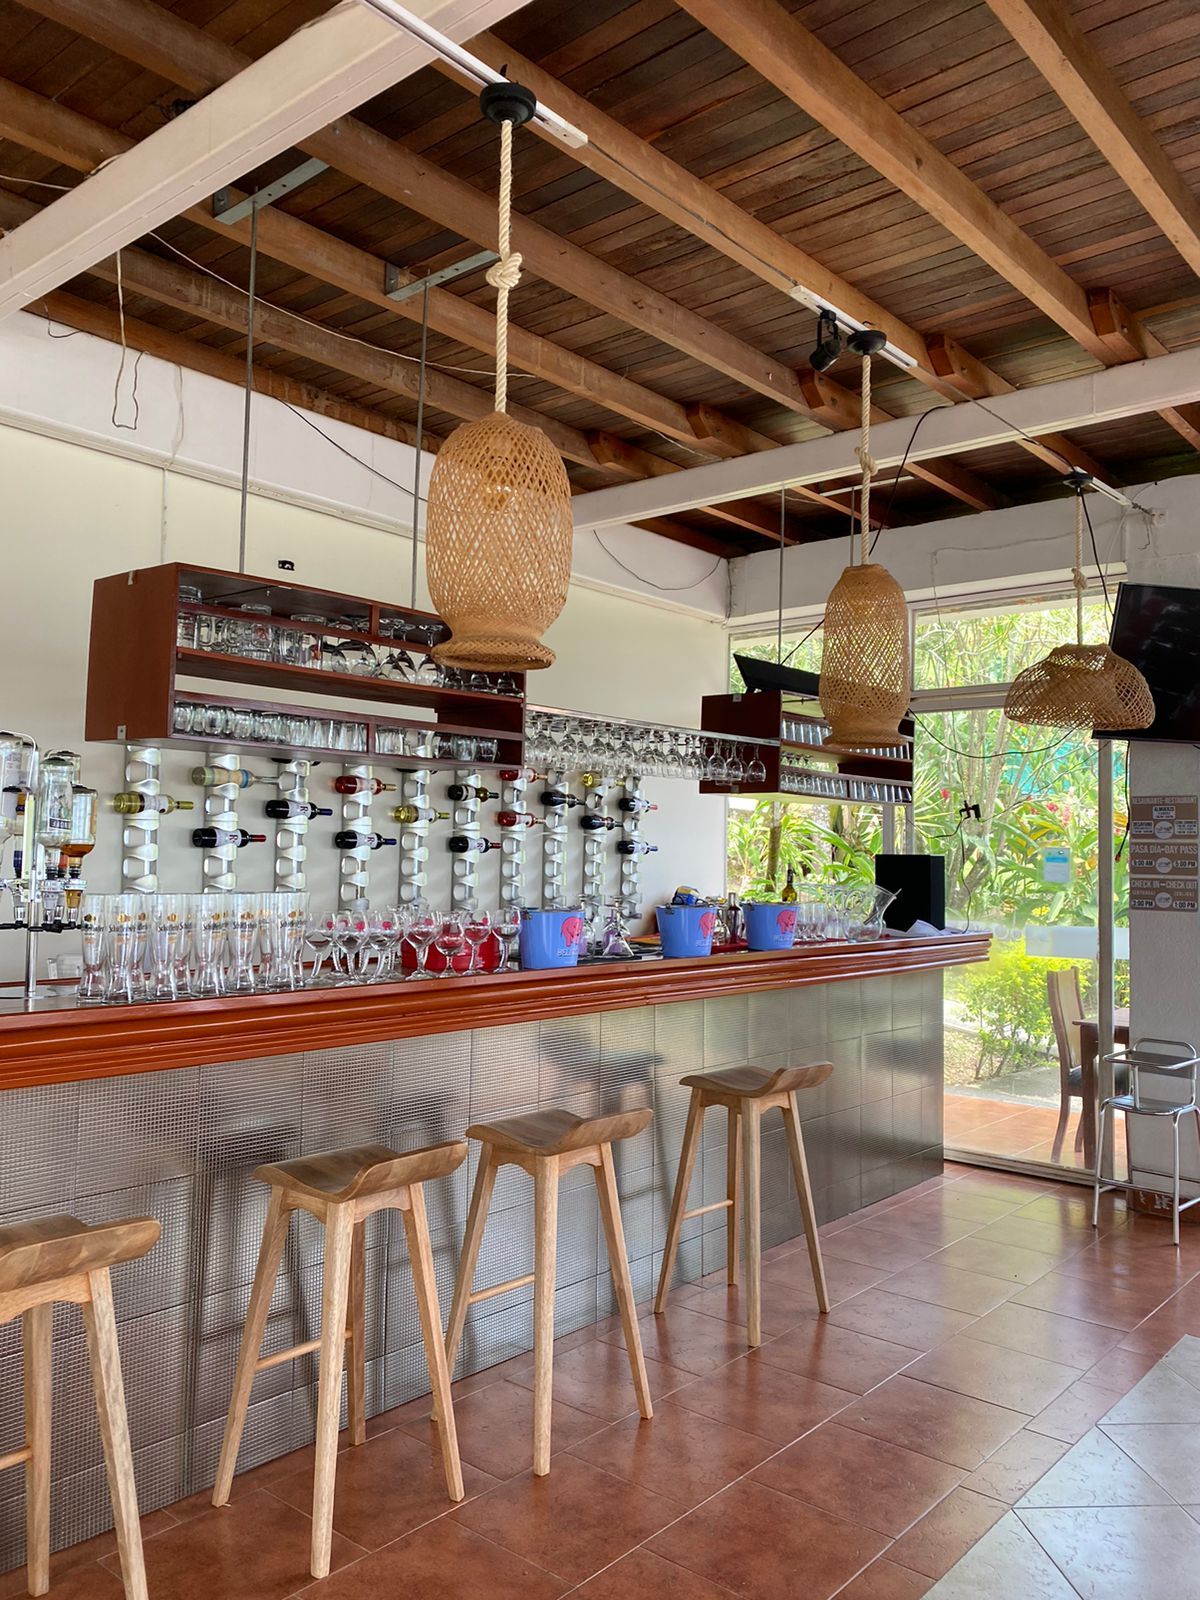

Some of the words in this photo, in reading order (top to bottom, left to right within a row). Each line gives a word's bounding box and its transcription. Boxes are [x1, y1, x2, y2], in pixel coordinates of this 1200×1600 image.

[1179, 844, 1198, 855] PASS
[1131, 880, 1152, 889] CHECK
[1185, 881, 1197, 890] OUT
